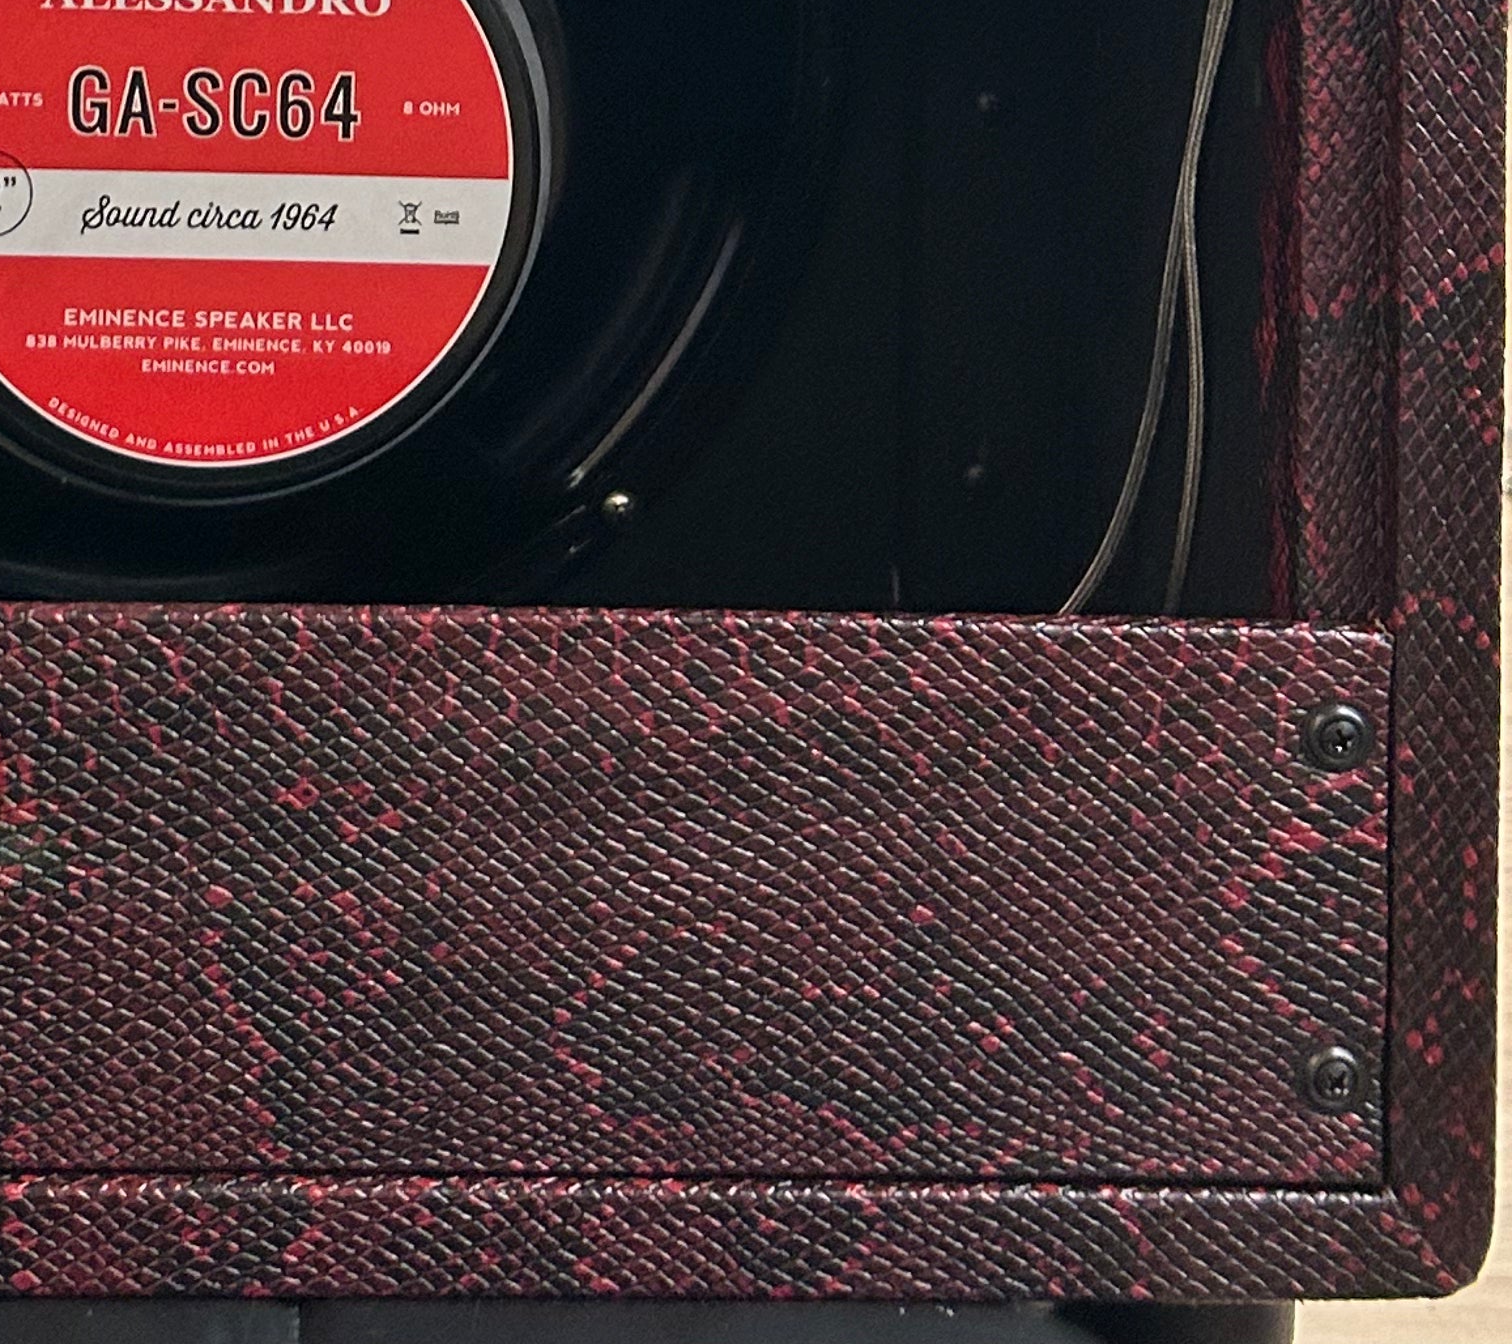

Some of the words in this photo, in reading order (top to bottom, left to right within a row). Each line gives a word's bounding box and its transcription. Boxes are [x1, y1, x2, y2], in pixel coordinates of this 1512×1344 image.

[68, 64, 361, 142] GA-SC64
[403, 101, 413, 114] 8
[419, 102, 461, 116] OHM
[80, 194, 181, 235] Sound
[187, 200, 263, 231] circa
[270, 204, 339, 231] 1964
[63, 308, 186, 328] EMINENCE
[194, 311, 302, 330] SPEAKER
[310, 313, 354, 331] LLC
[25, 334, 57, 349] 838
[63, 335, 157, 350] MULBERRY
[312, 339, 336, 353] KY
[342, 340, 392, 355] 40019
[141, 359, 275, 375] EMINENCE.COM
[48, 396, 120, 440] DESIGNED
[125, 432, 158, 451] AND
[163, 441, 256, 457] ASSEMBLED
[262, 436, 280, 451] IN
[285, 426, 315, 444] THE
